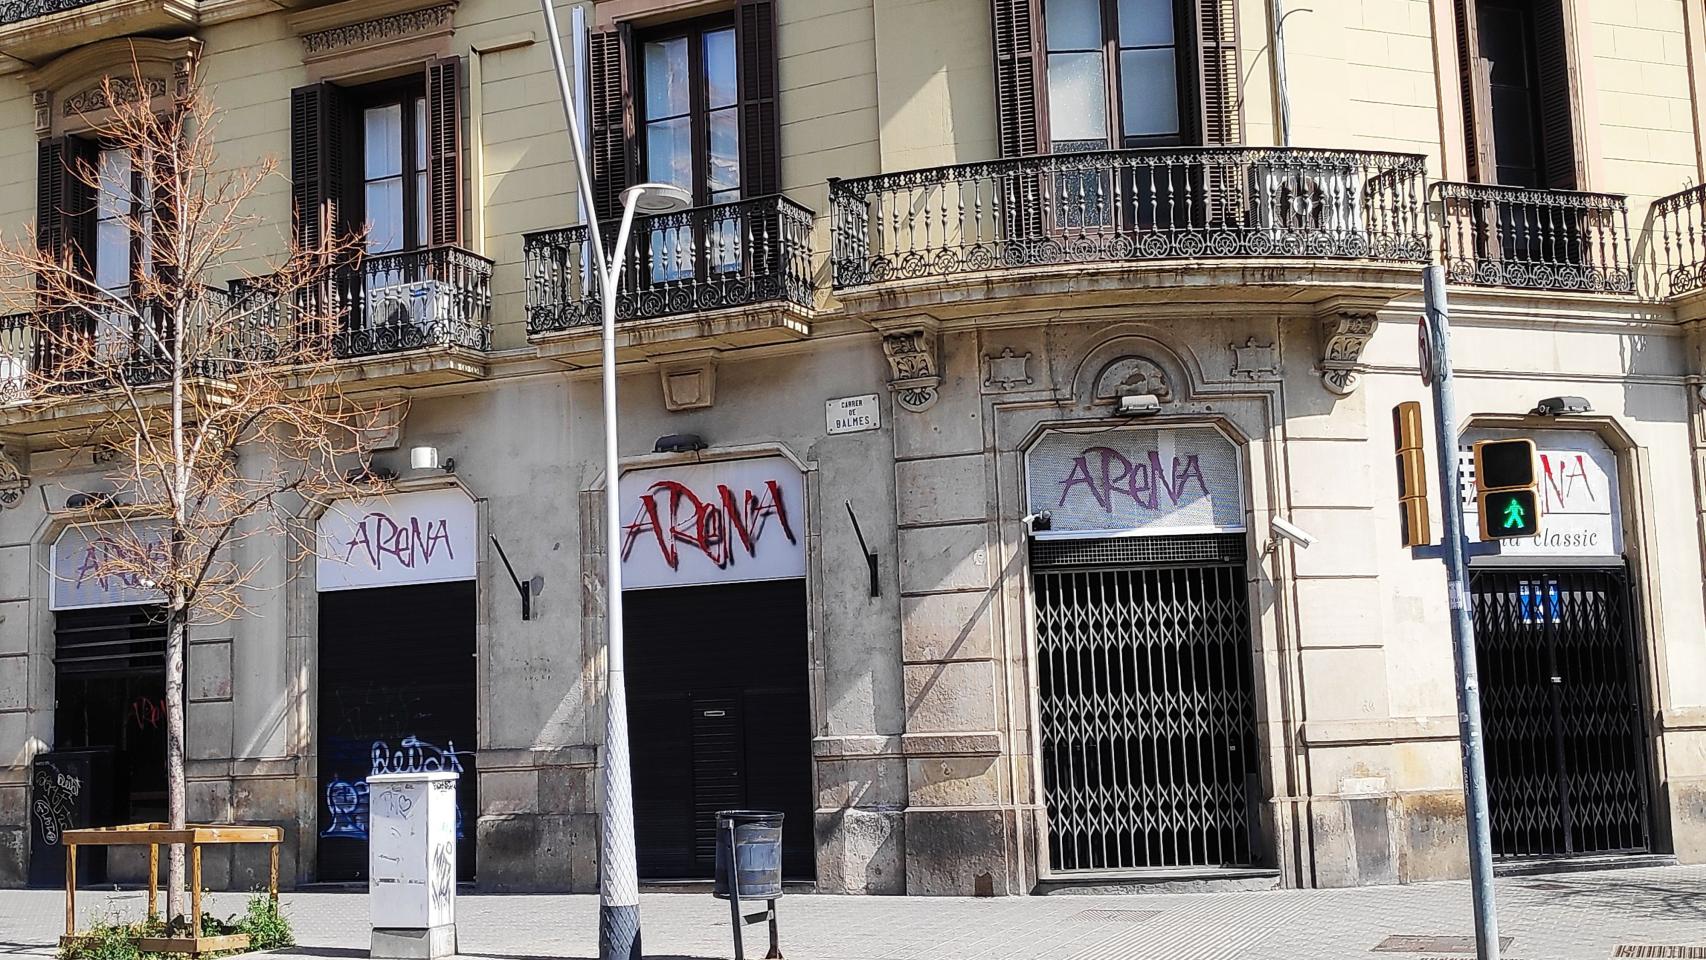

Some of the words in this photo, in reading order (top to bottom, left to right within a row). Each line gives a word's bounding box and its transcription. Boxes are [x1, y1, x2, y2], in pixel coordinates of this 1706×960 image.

[841, 400, 863, 408] CARRER
[836, 416, 869, 428] BALMES
[1534, 527, 1598, 547] classic
